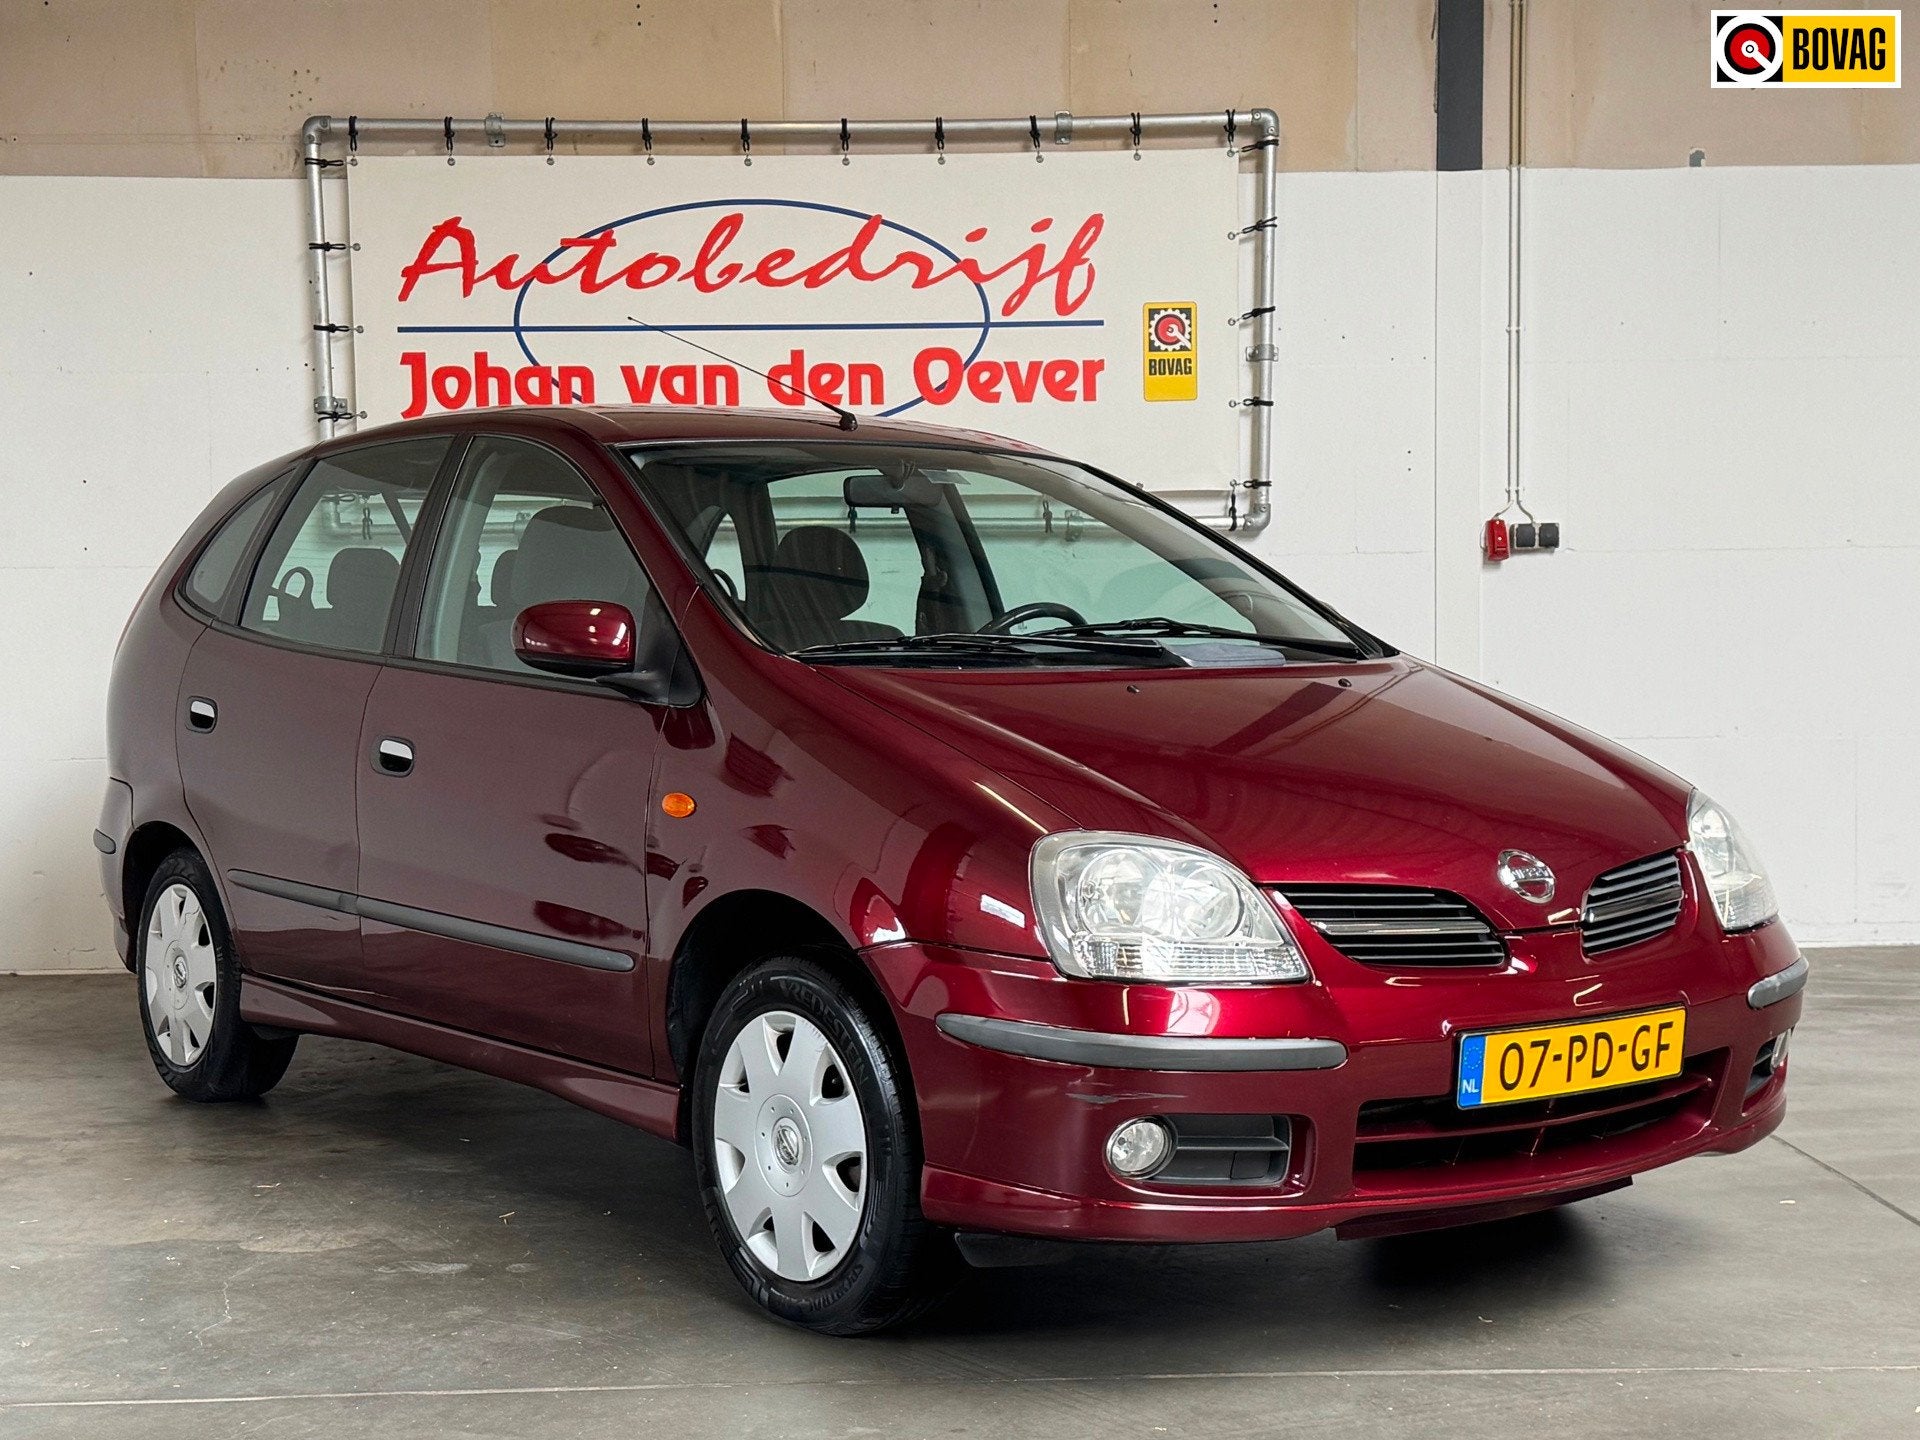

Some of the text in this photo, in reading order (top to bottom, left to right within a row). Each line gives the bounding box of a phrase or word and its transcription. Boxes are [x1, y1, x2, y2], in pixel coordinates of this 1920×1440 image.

[399, 214, 1104, 316] Autobedrijf
[401, 347, 1105, 419] Johan van den Oever
[1148, 358, 1192, 376] BOVAG
[1462, 1079, 1479, 1094] NL
[1499, 1021, 1674, 1091] 07-PD-GF
